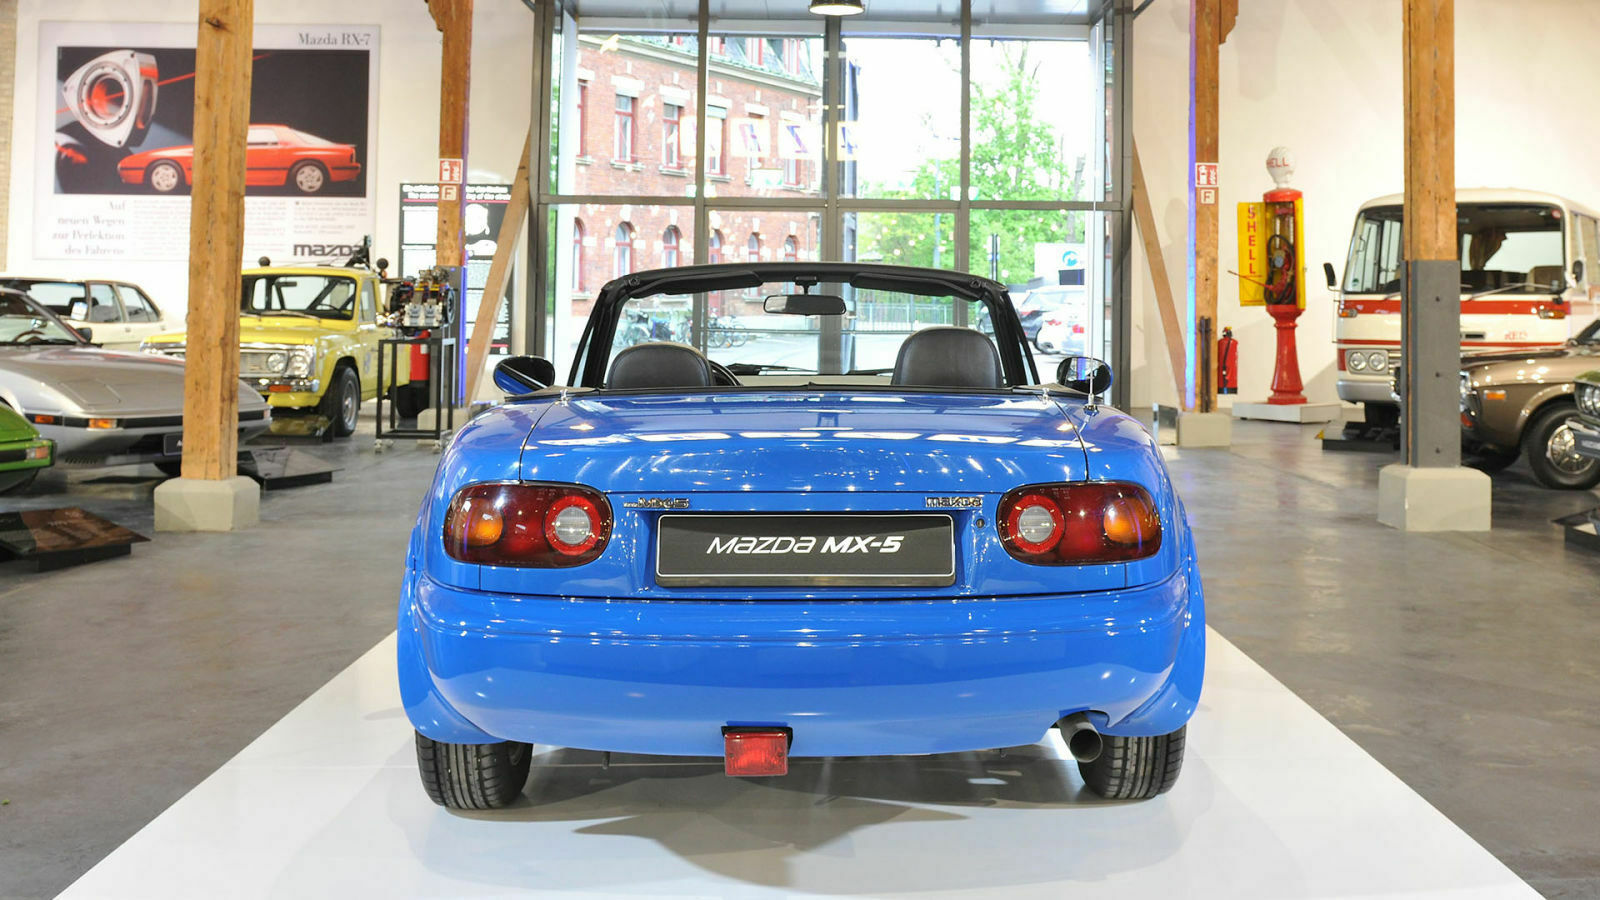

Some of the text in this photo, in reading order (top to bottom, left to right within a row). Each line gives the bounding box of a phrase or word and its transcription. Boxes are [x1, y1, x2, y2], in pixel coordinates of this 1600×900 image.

[298, 32, 371, 45] Mazda RX-7
[444, 187, 454, 199] F
[1203, 191, 1211, 202] F
[1247, 204, 1257, 274] SHELL
[820, 536, 905, 553] MX-5
